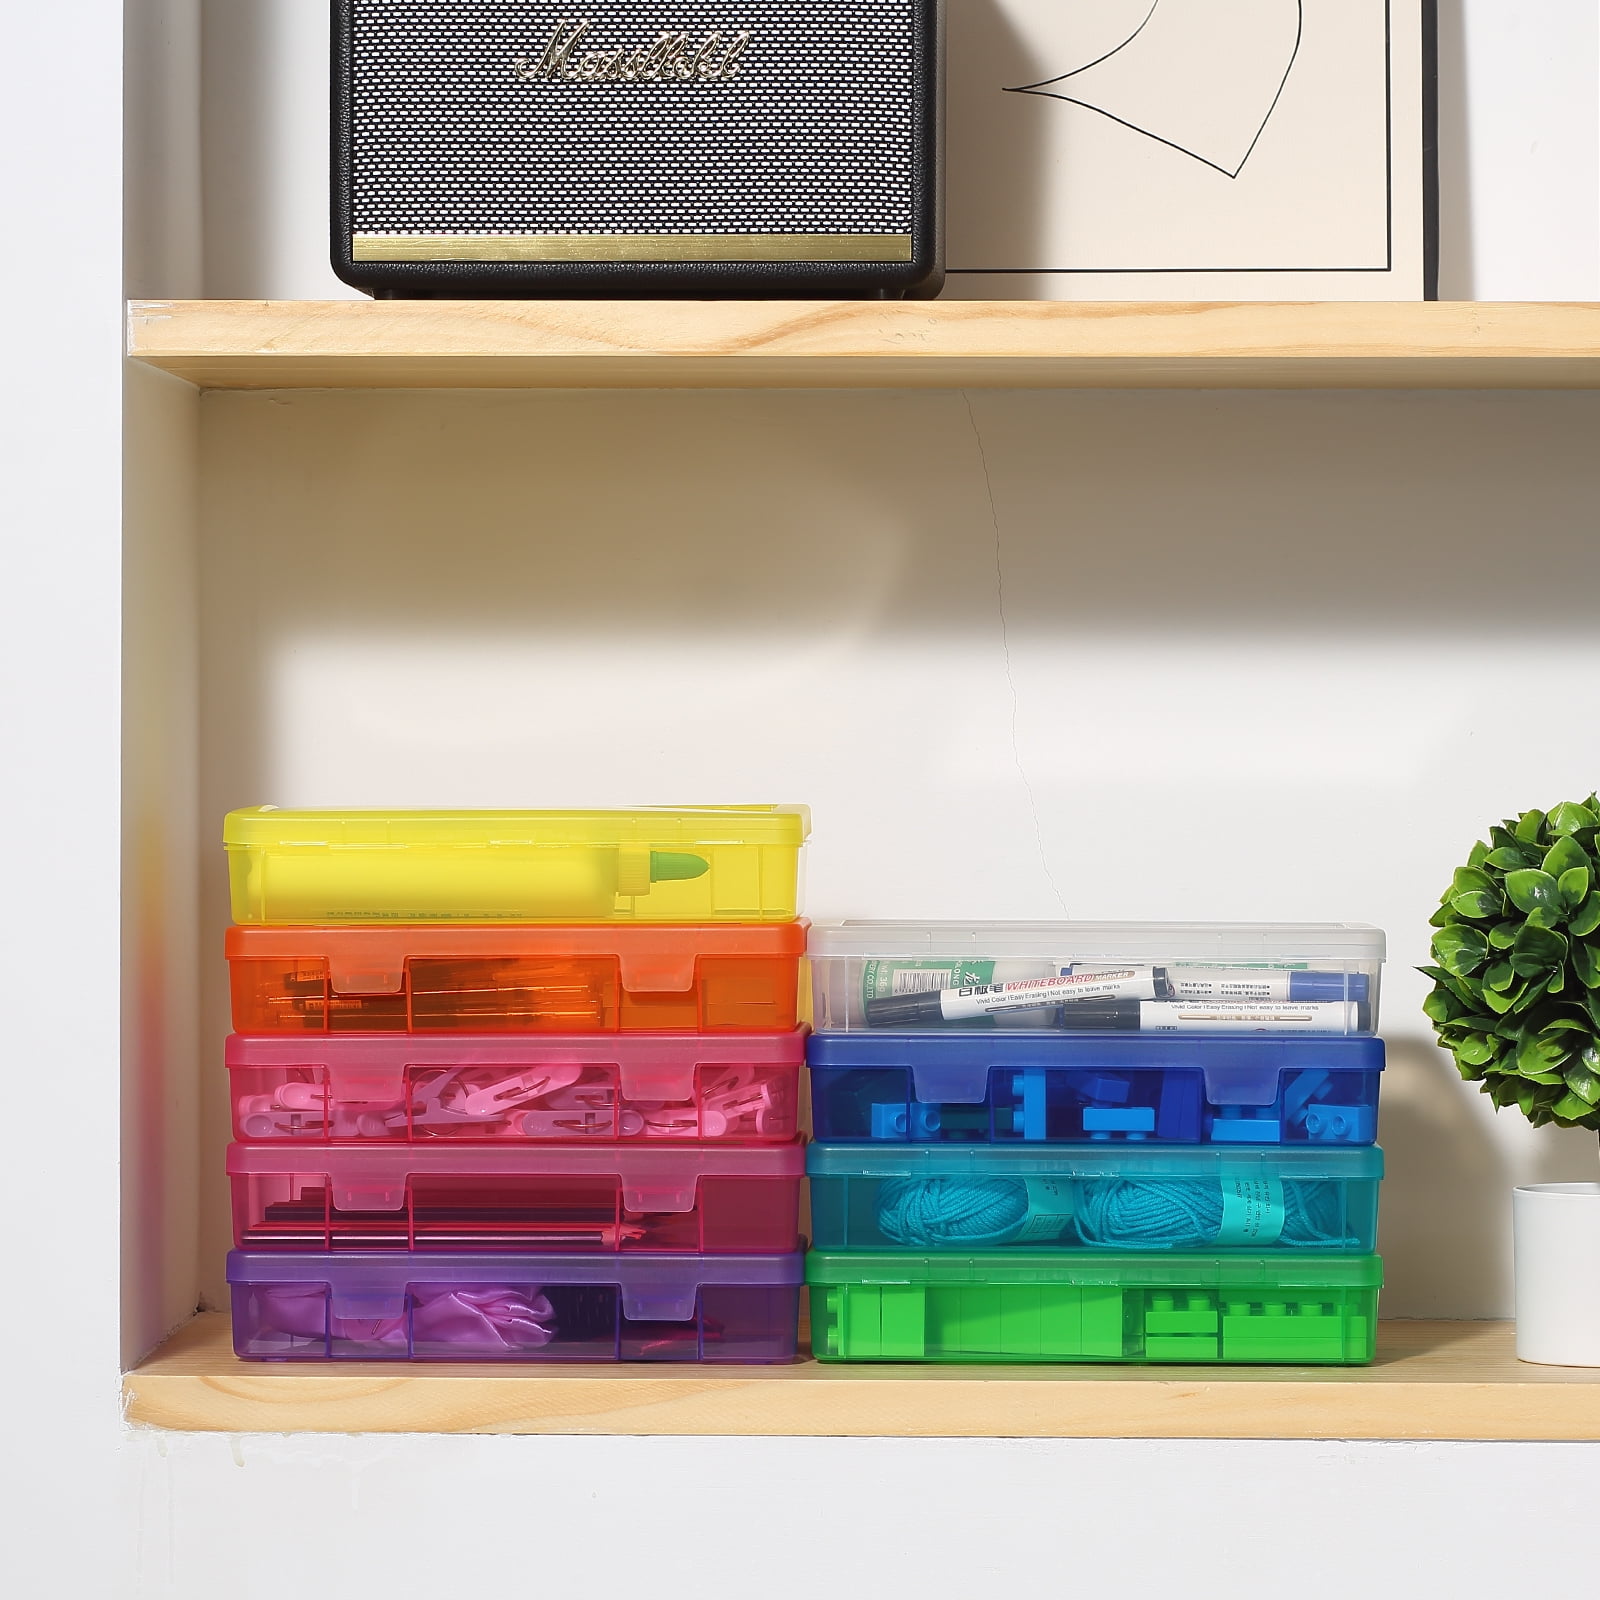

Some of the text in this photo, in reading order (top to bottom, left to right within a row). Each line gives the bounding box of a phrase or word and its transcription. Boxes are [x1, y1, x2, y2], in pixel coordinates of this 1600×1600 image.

[958, 970, 1129, 997] 白板笔 WHITEBOARD MARKER
[976, 997, 991, 1005] Vivid
[991, 995, 1007, 1003] Color
[1025, 990, 1047, 1001] Erasing
[1062, 989, 1076, 997] easy
[1102, 983, 1121, 991] marks
